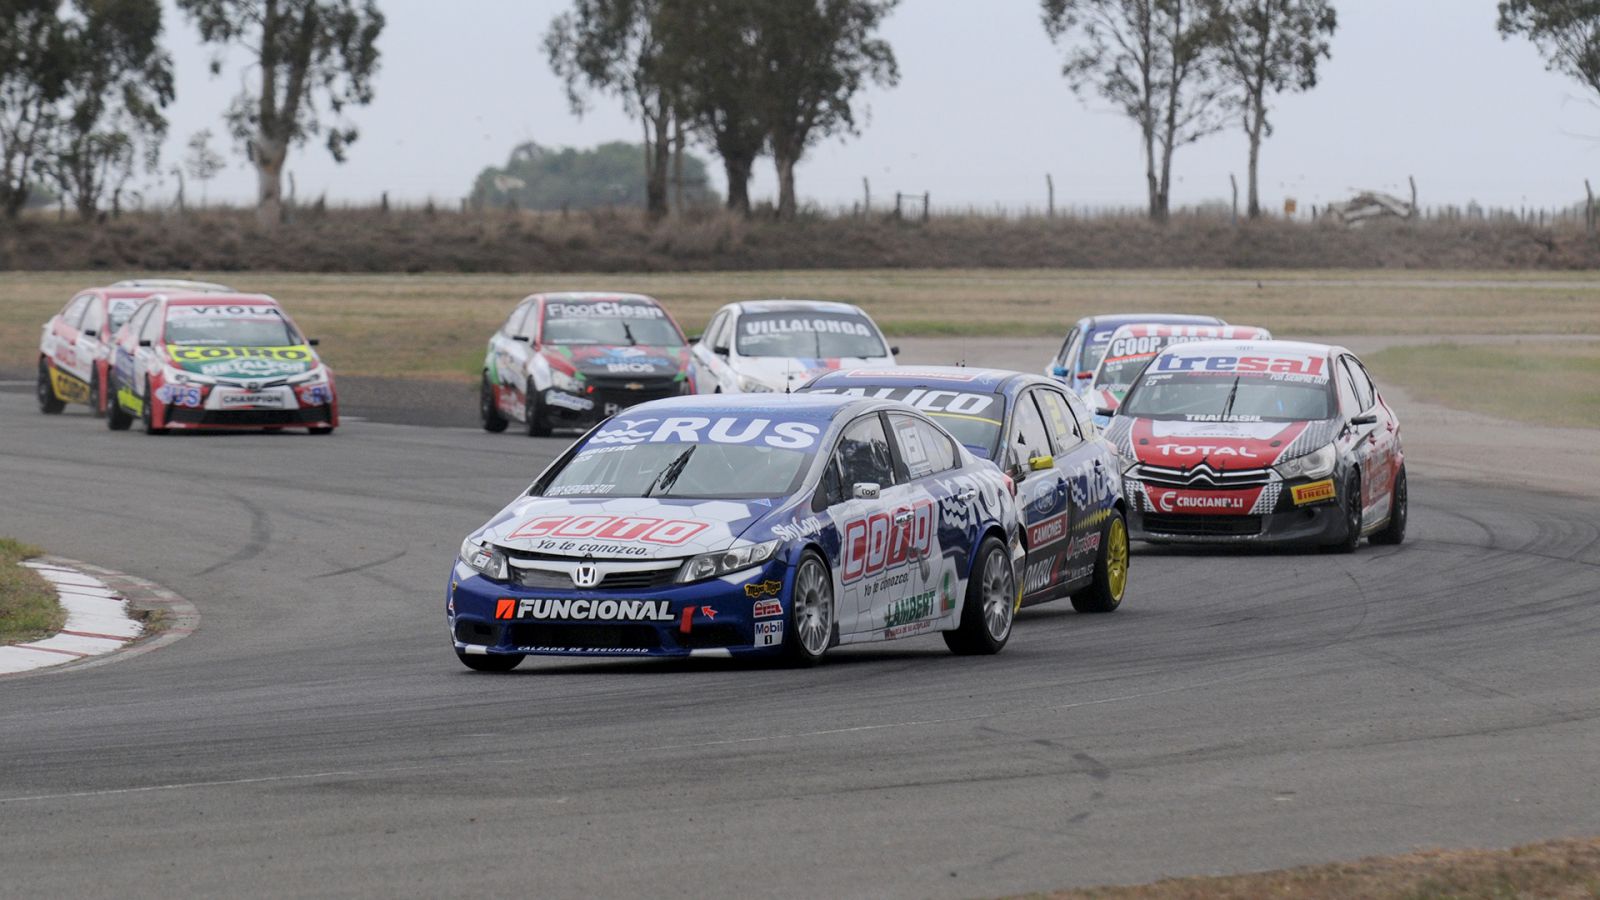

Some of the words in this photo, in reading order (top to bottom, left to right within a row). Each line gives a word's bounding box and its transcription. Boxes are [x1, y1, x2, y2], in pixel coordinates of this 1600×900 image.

[547, 302, 663, 318] FloorClean
[746, 319, 871, 337] VILLALONGA
[1157, 353, 1324, 376] tresal
[223, 395, 281, 403] CHAMPION
[649, 417, 820, 449] RUS
[1156, 444, 1258, 458] TOTAL
[507, 515, 709, 544] COTO
[843, 499, 932, 581] COTO
[1033, 518, 1062, 545] CAMIONES
[537, 539, 555, 549] Yo
[559, 541, 576, 551] te
[517, 599, 675, 620] FUNCIONAL
[886, 591, 935, 628] LAMBERT
[755, 622, 783, 635] Mobil
